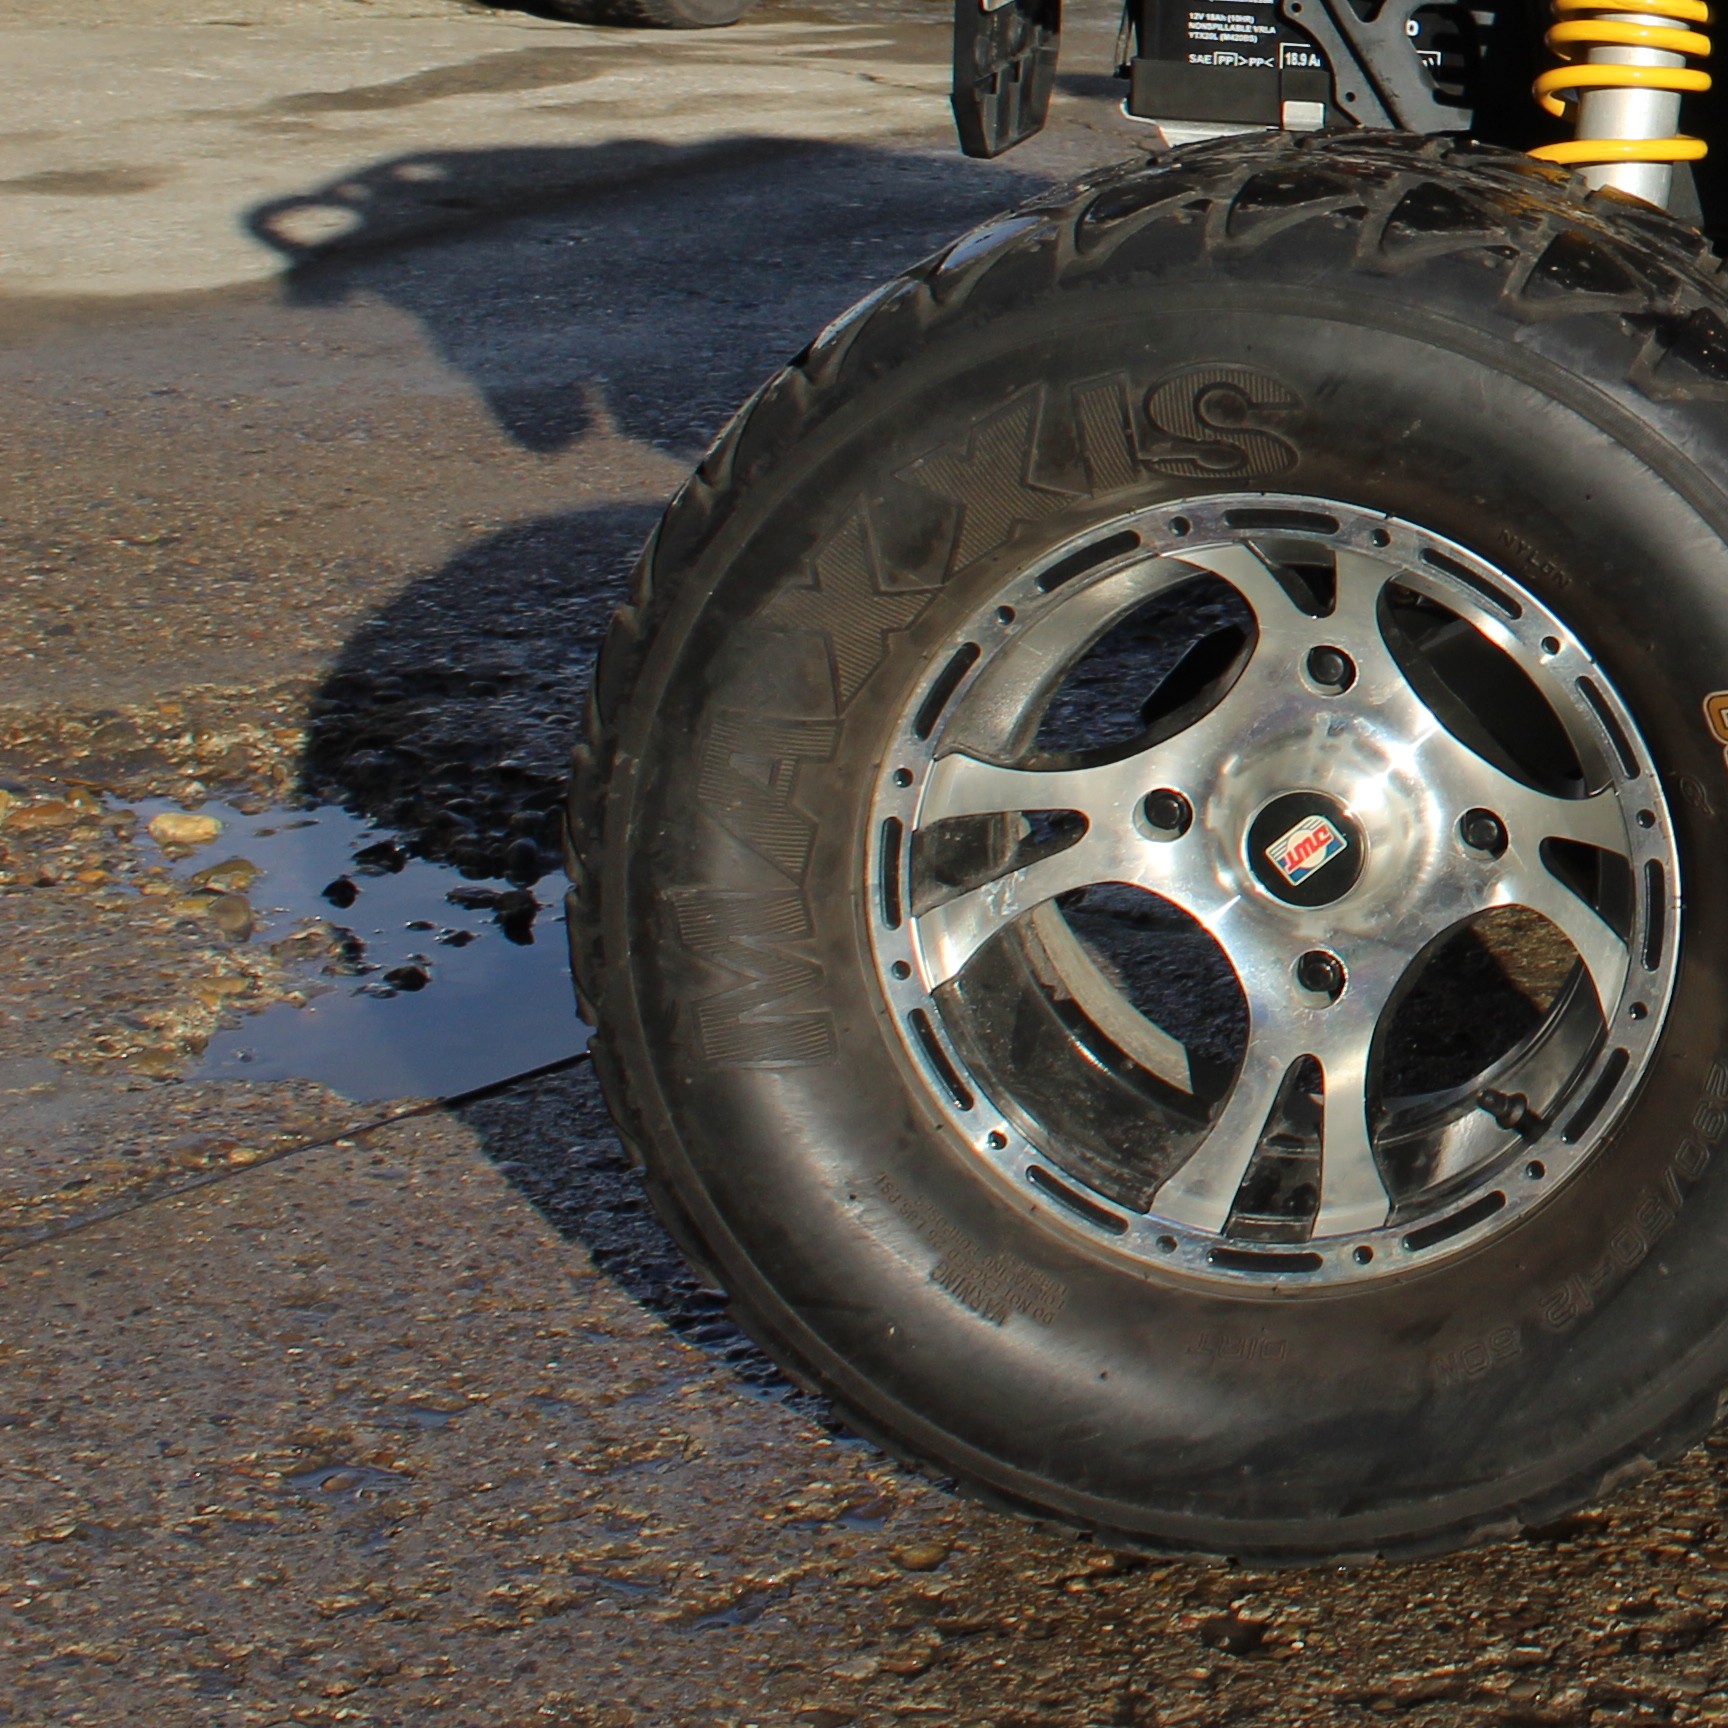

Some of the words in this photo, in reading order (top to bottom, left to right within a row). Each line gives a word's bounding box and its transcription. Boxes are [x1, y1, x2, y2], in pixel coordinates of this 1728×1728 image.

[1188, 53, 1213, 65] SAE
[1497, 524, 1573, 591] NYLON
[662, 362, 1302, 1070] MAXXIS
[929, 1260, 1008, 1327] WARNING
